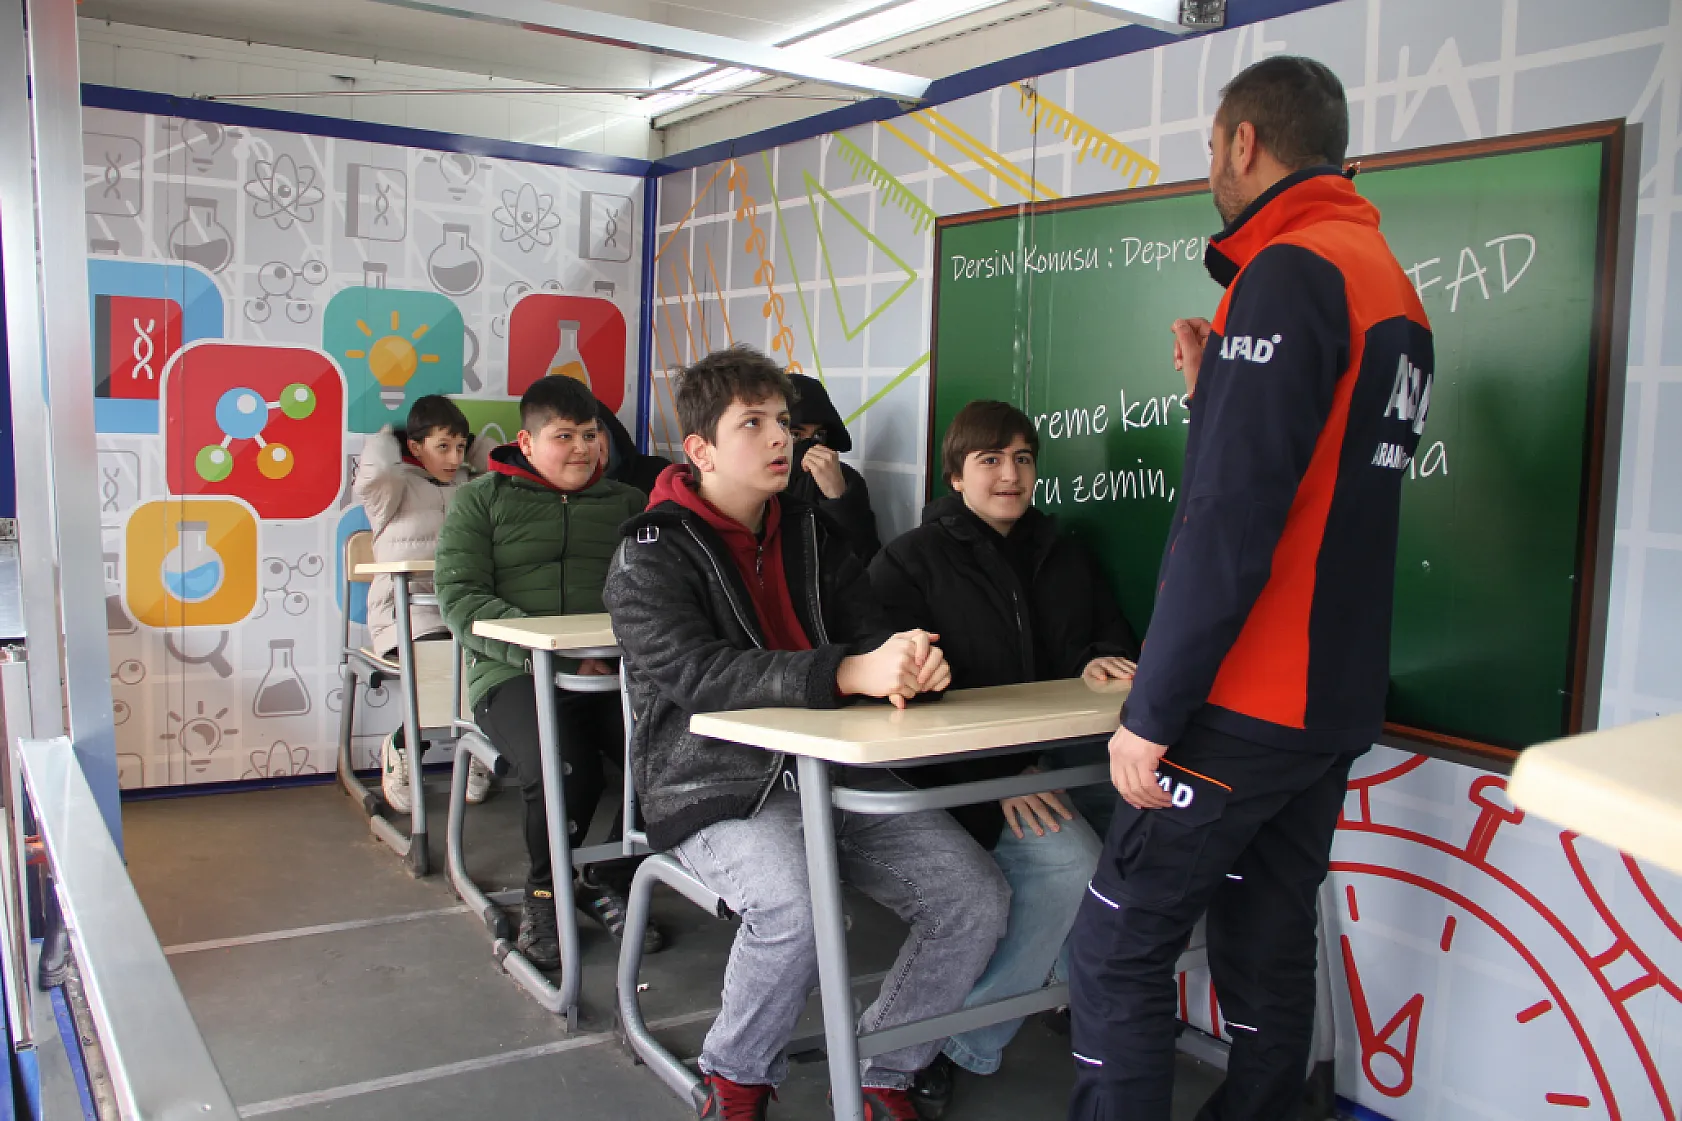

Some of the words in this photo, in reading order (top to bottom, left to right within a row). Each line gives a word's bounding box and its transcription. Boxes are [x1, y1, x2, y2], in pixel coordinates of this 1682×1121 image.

[1023, 244, 1099, 274] Konusu
[1404, 233, 1536, 313] FAD
[1219, 335, 1274, 364] AFAD
[1034, 389, 1109, 439] reme
[1120, 388, 1191, 432] kars
[1031, 476, 1062, 506] ru
[1072, 458, 1175, 503] zemin,
[1154, 771, 1194, 808] AD
